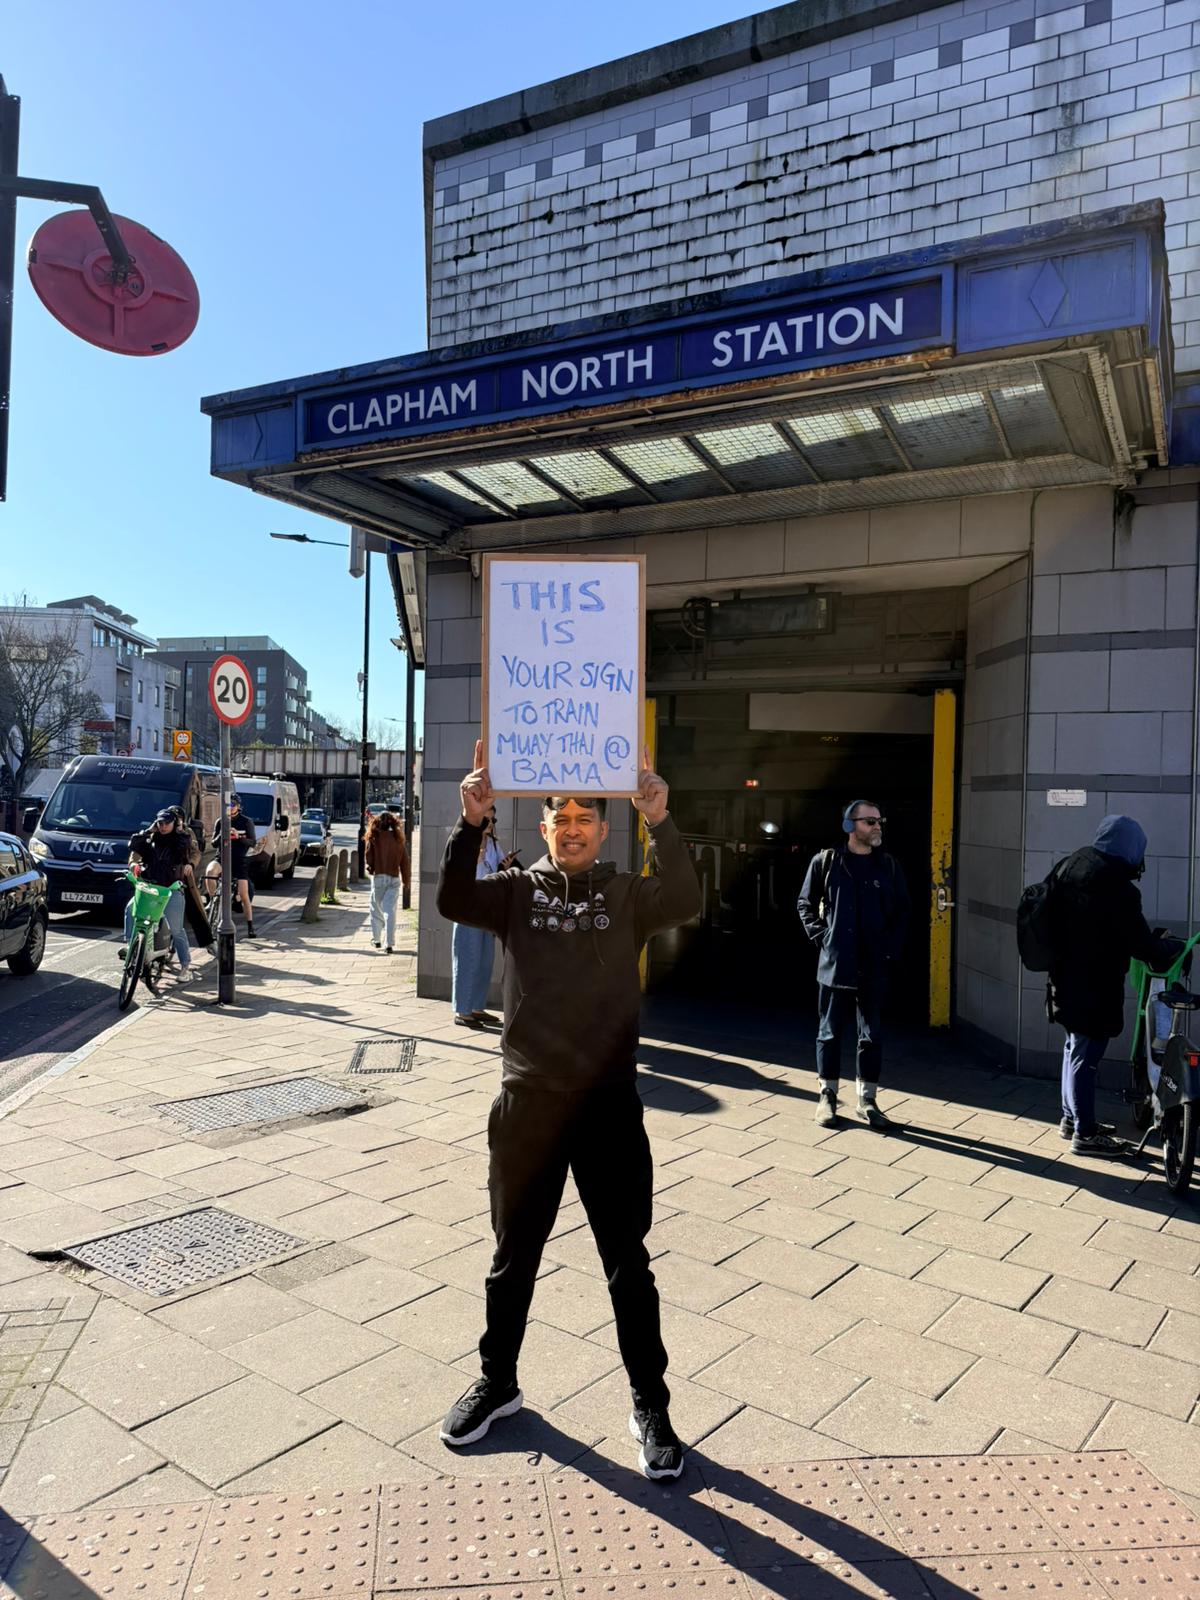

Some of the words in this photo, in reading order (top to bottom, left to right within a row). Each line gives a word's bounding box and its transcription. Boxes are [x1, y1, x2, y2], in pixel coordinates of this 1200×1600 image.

[327, 379, 477, 434] CLAPHAM
[522, 345, 653, 401] NORTH
[711, 298, 904, 368] STATION
[500, 580, 606, 613] THIS
[541, 618, 575, 647] IS
[501, 655, 573, 690] YOUR
[580, 662, 634, 694] SIGN
[216, 675, 246, 705] 20
[502, 700, 538, 725] TO
[542, 698, 599, 728] TRAIN
[496, 731, 554, 758] MUAY
[556, 731, 595, 757] THAI
[604, 735, 630, 770] @
[97, 761, 160, 771] MAINTENANCE
[107, 767, 147, 775] DIVISION
[511, 758, 607, 790] BAMA
[69, 839, 117, 855] KNK
[64, 893, 85, 901] LL72
[86, 894, 101, 902] AKY
